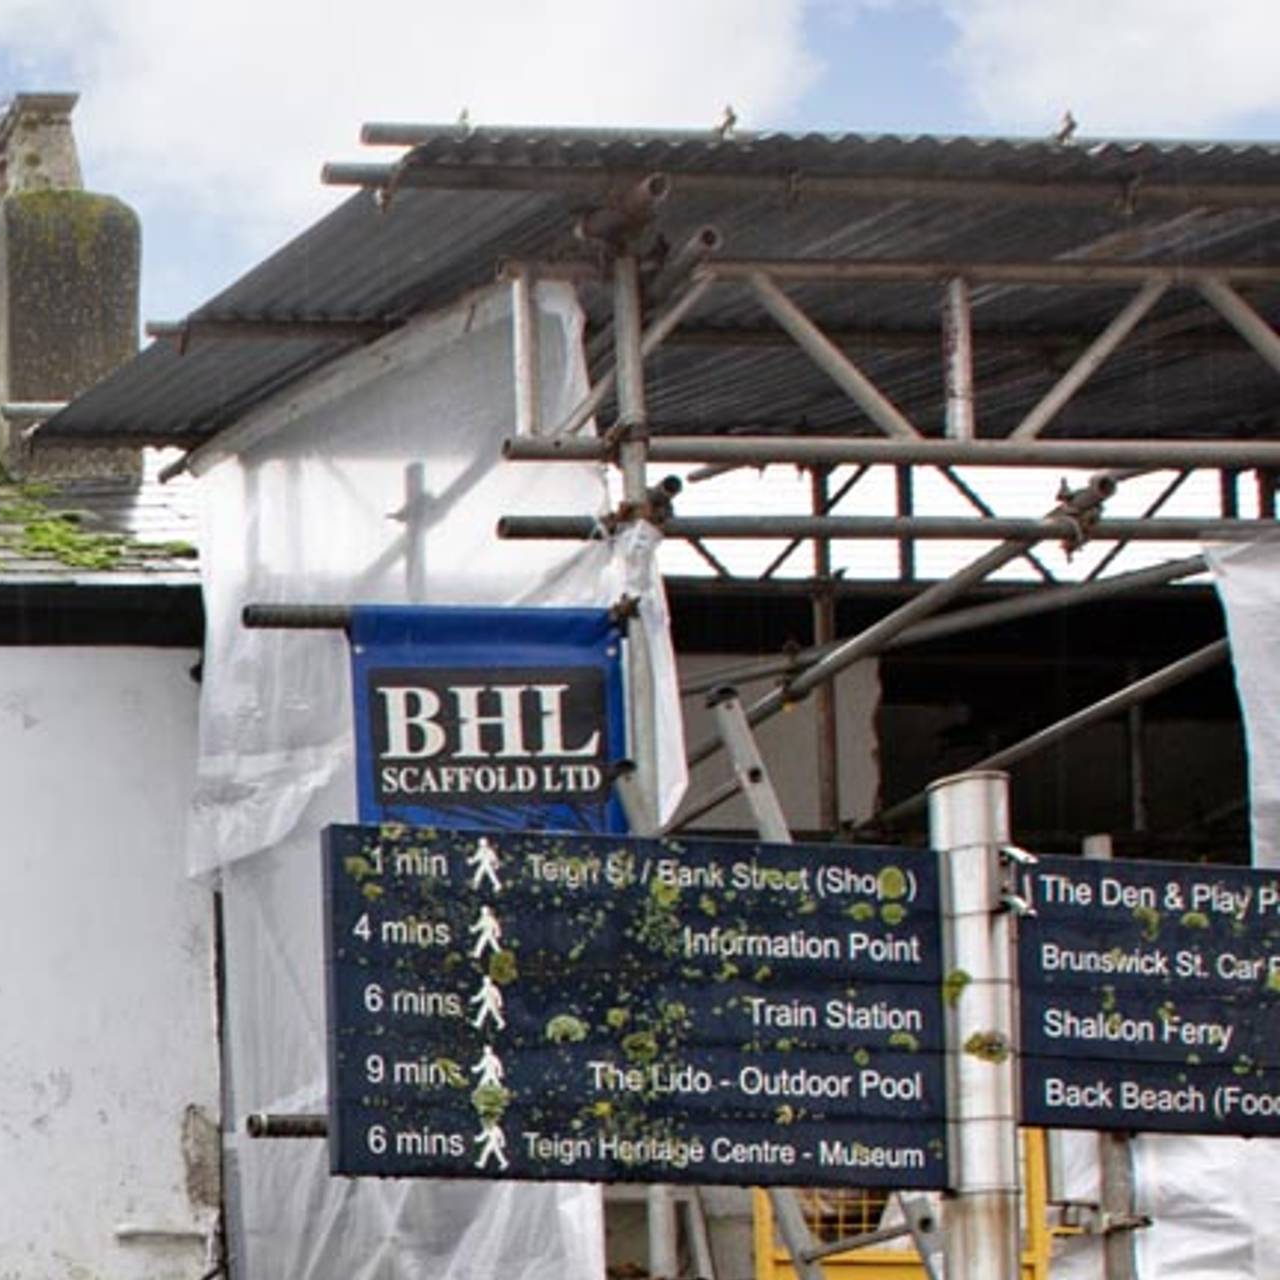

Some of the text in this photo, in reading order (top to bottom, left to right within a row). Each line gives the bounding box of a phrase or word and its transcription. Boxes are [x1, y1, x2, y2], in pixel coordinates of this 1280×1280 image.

[376, 683, 601, 759] BHL
[381, 764, 602, 794] SCAFFOLD LTD
[371, 846, 449, 877] 1 min
[527, 854, 600, 889] Teign
[657, 860, 725, 890] Bank
[731, 861, 810, 892] Street
[1040, 873, 1092, 905] The
[1101, 879, 1156, 908] Den
[1163, 881, 1185, 911] &
[1191, 883, 1252, 921] Play
[352, 914, 372, 943] 4
[684, 926, 921, 963] Information Point
[1041, 943, 1169, 976] Brunswick
[1175, 950, 1209, 977] St.
[1216, 953, 1264, 980] Car
[363, 983, 463, 1017] 6 mins
[750, 998, 922, 1032] Train Station
[1043, 1008, 1234, 1053] Shaldon Ferry
[365, 1054, 463, 1086] 9 mins
[587, 1061, 644, 1093] The
[653, 1063, 712, 1094] Lido
[739, 1064, 852, 1098] Outdoor
[859, 1068, 922, 1100] Pool
[1045, 1077, 1113, 1109] Back
[1119, 1081, 1206, 1114] Beach
[366, 1125, 466, 1158] 6 mins
[523, 1131, 591, 1164] Teign
[598, 1133, 704, 1169] Heritage
[710, 1136, 796, 1166] Centre
[819, 1140, 925, 1169] Museum
